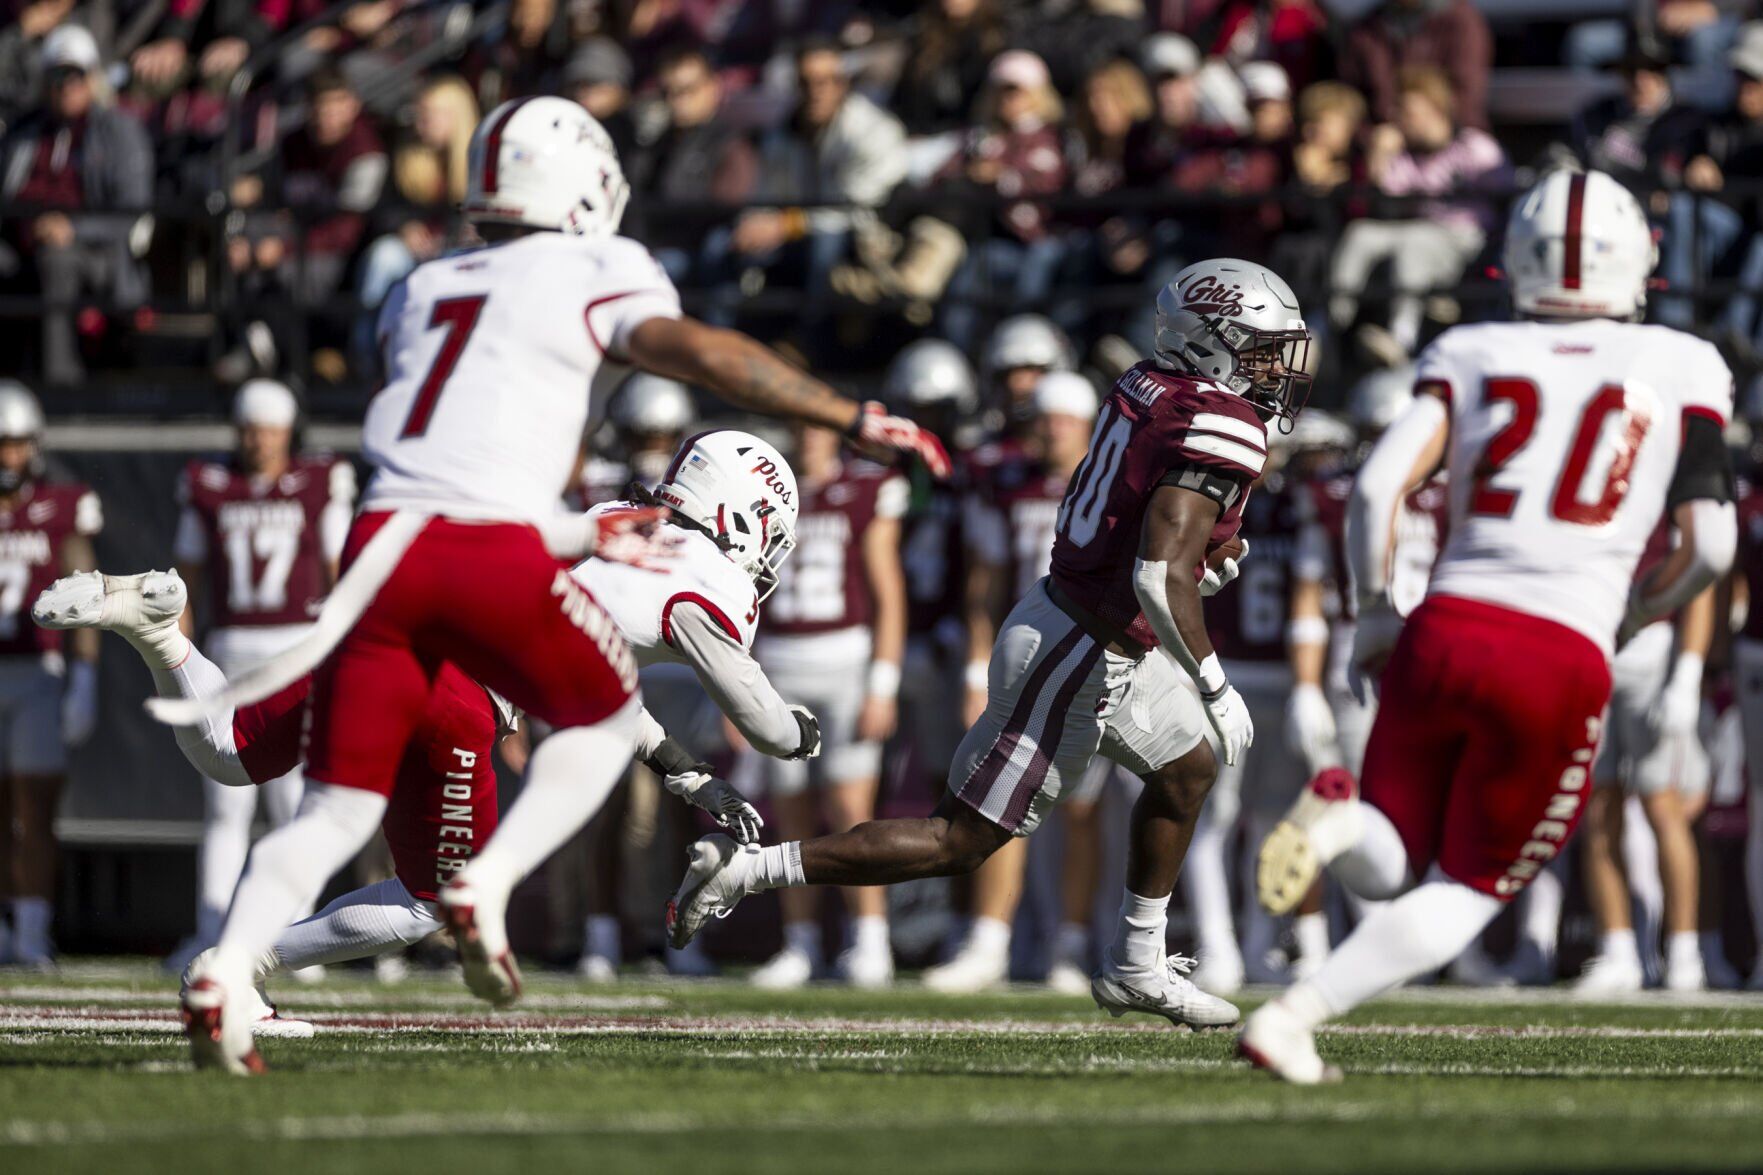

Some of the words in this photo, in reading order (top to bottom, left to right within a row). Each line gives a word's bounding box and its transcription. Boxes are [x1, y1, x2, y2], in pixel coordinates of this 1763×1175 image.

[1183, 276, 1243, 316] Griz
[396, 293, 490, 441] 7
[751, 456, 791, 505] Pios
[1056, 402, 1133, 548] 10
[1467, 375, 1653, 528] 20
[225, 524, 301, 612] 17
